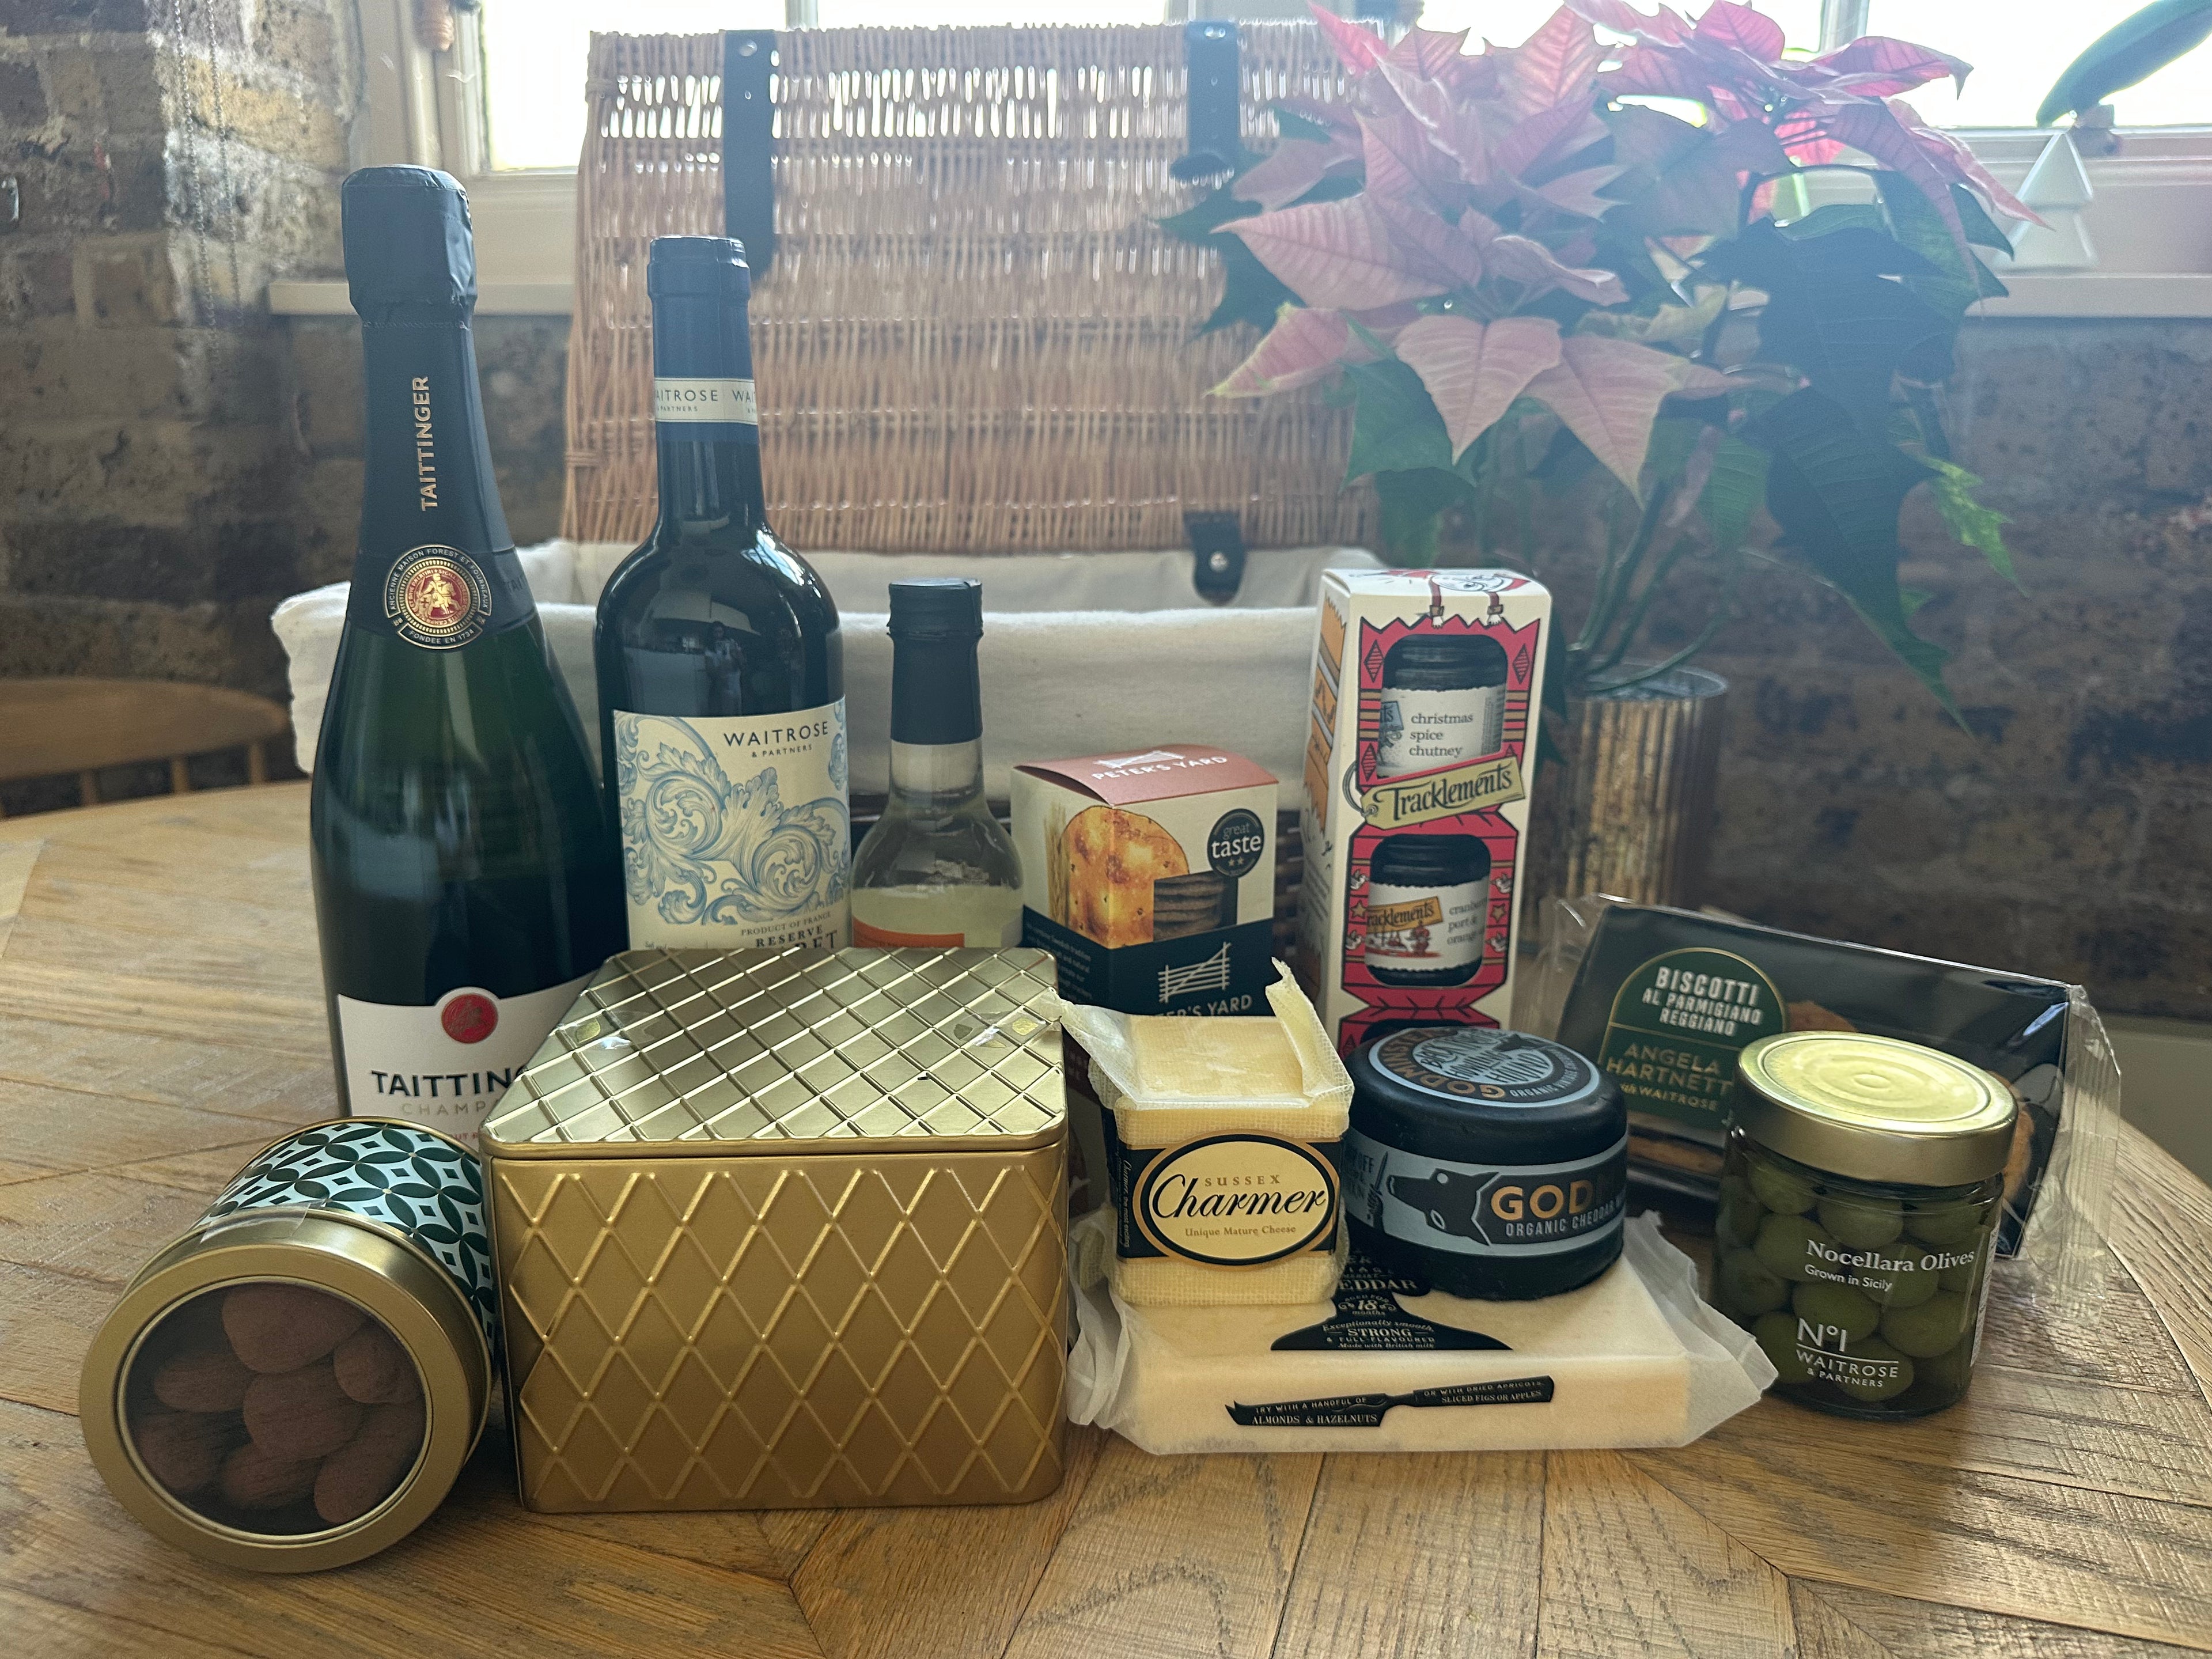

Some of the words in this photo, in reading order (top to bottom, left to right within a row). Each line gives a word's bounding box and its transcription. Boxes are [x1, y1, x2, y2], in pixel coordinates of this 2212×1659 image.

[412, 376, 438, 512] TAITTINGER
[389, 573, 400, 610] ANCIENNE
[398, 549, 425, 571] MAISON
[427, 548, 459, 558] FOREST
[460, 554, 471, 565] ET
[470, 565, 488, 609] FOURNEAUX
[458, 629, 474, 640] 1734
[1411, 713, 1474, 725] christmas
[724, 721, 828, 747] WAITROSE
[1410, 729, 1444, 743] spice
[763, 744, 813, 757] PARTNERS
[1409, 745, 1463, 759] chutney
[1172, 756, 1228, 768] YARD
[1372, 760, 1513, 821] Tracklements
[1222, 822, 1249, 840] great
[1211, 835, 1262, 858] taste
[741, 923, 786, 936] PRODUCT
[804, 912, 831, 924] FRANCE
[756, 925, 823, 948] RESERVE
[1654, 966, 1761, 1007] BISCOTTI
[1207, 994, 1253, 1016] YARD
[1642, 987, 1661, 1006] AL
[1665, 991, 1764, 1027] PARMIGIANO
[1659, 1008, 1737, 1037] REGGIANO
[1624, 1043, 1721, 1075] ANGELA
[371, 1065, 527, 1097] TAITTIN
[1606, 1056, 1734, 1095] HARTNETT
[1509, 1085, 1559, 1097] ORGANIC
[1639, 1085, 1718, 1112] WAITROSE
[1205, 1175, 1281, 1187] SUSSEX
[1152, 1173, 1326, 1219] Charmer
[1185, 1228, 1220, 1238] Unique
[1224, 1226, 1258, 1236] Mature
[1262, 1225, 1296, 1234] Cheese
[1506, 1218, 1567, 1237] ORGANIC
[1806, 1238, 1914, 1272] Nocellara
[1921, 1250, 1975, 1271] Olives
[1805, 1264, 1844, 1283] Grown
[1848, 1274, 1859, 1286] in
[1862, 1276, 1893, 1292] Sicily
[1357, 1300, 1379, 1310] 18
[1323, 1320, 1392, 1332] Exceptionally
[1347, 1328, 1412, 1338] STRONG
[1796, 1350, 1900, 1378] WAITROSE
[1467, 1384, 1493, 1393] DRIED
[1806, 1368, 1813, 1376] &
[1819, 1370, 1884, 1388] PARTNERS
[1256, 1406, 1271, 1414] TRY
[1276, 1404, 1298, 1412] WITH
[1312, 1397, 1351, 1408] HANDFUL
[1441, 1395, 1474, 1403] SLICED
[1475, 1393, 1495, 1402] FIGS
[1497, 1393, 1509, 1401] OR
[1510, 1389, 1541, 1401] APPLES
[1252, 1415, 1300, 1425] ALMONDS
[1305, 1415, 1315, 1425] &
[1317, 1414, 1378, 1425] HAZELNUTS
